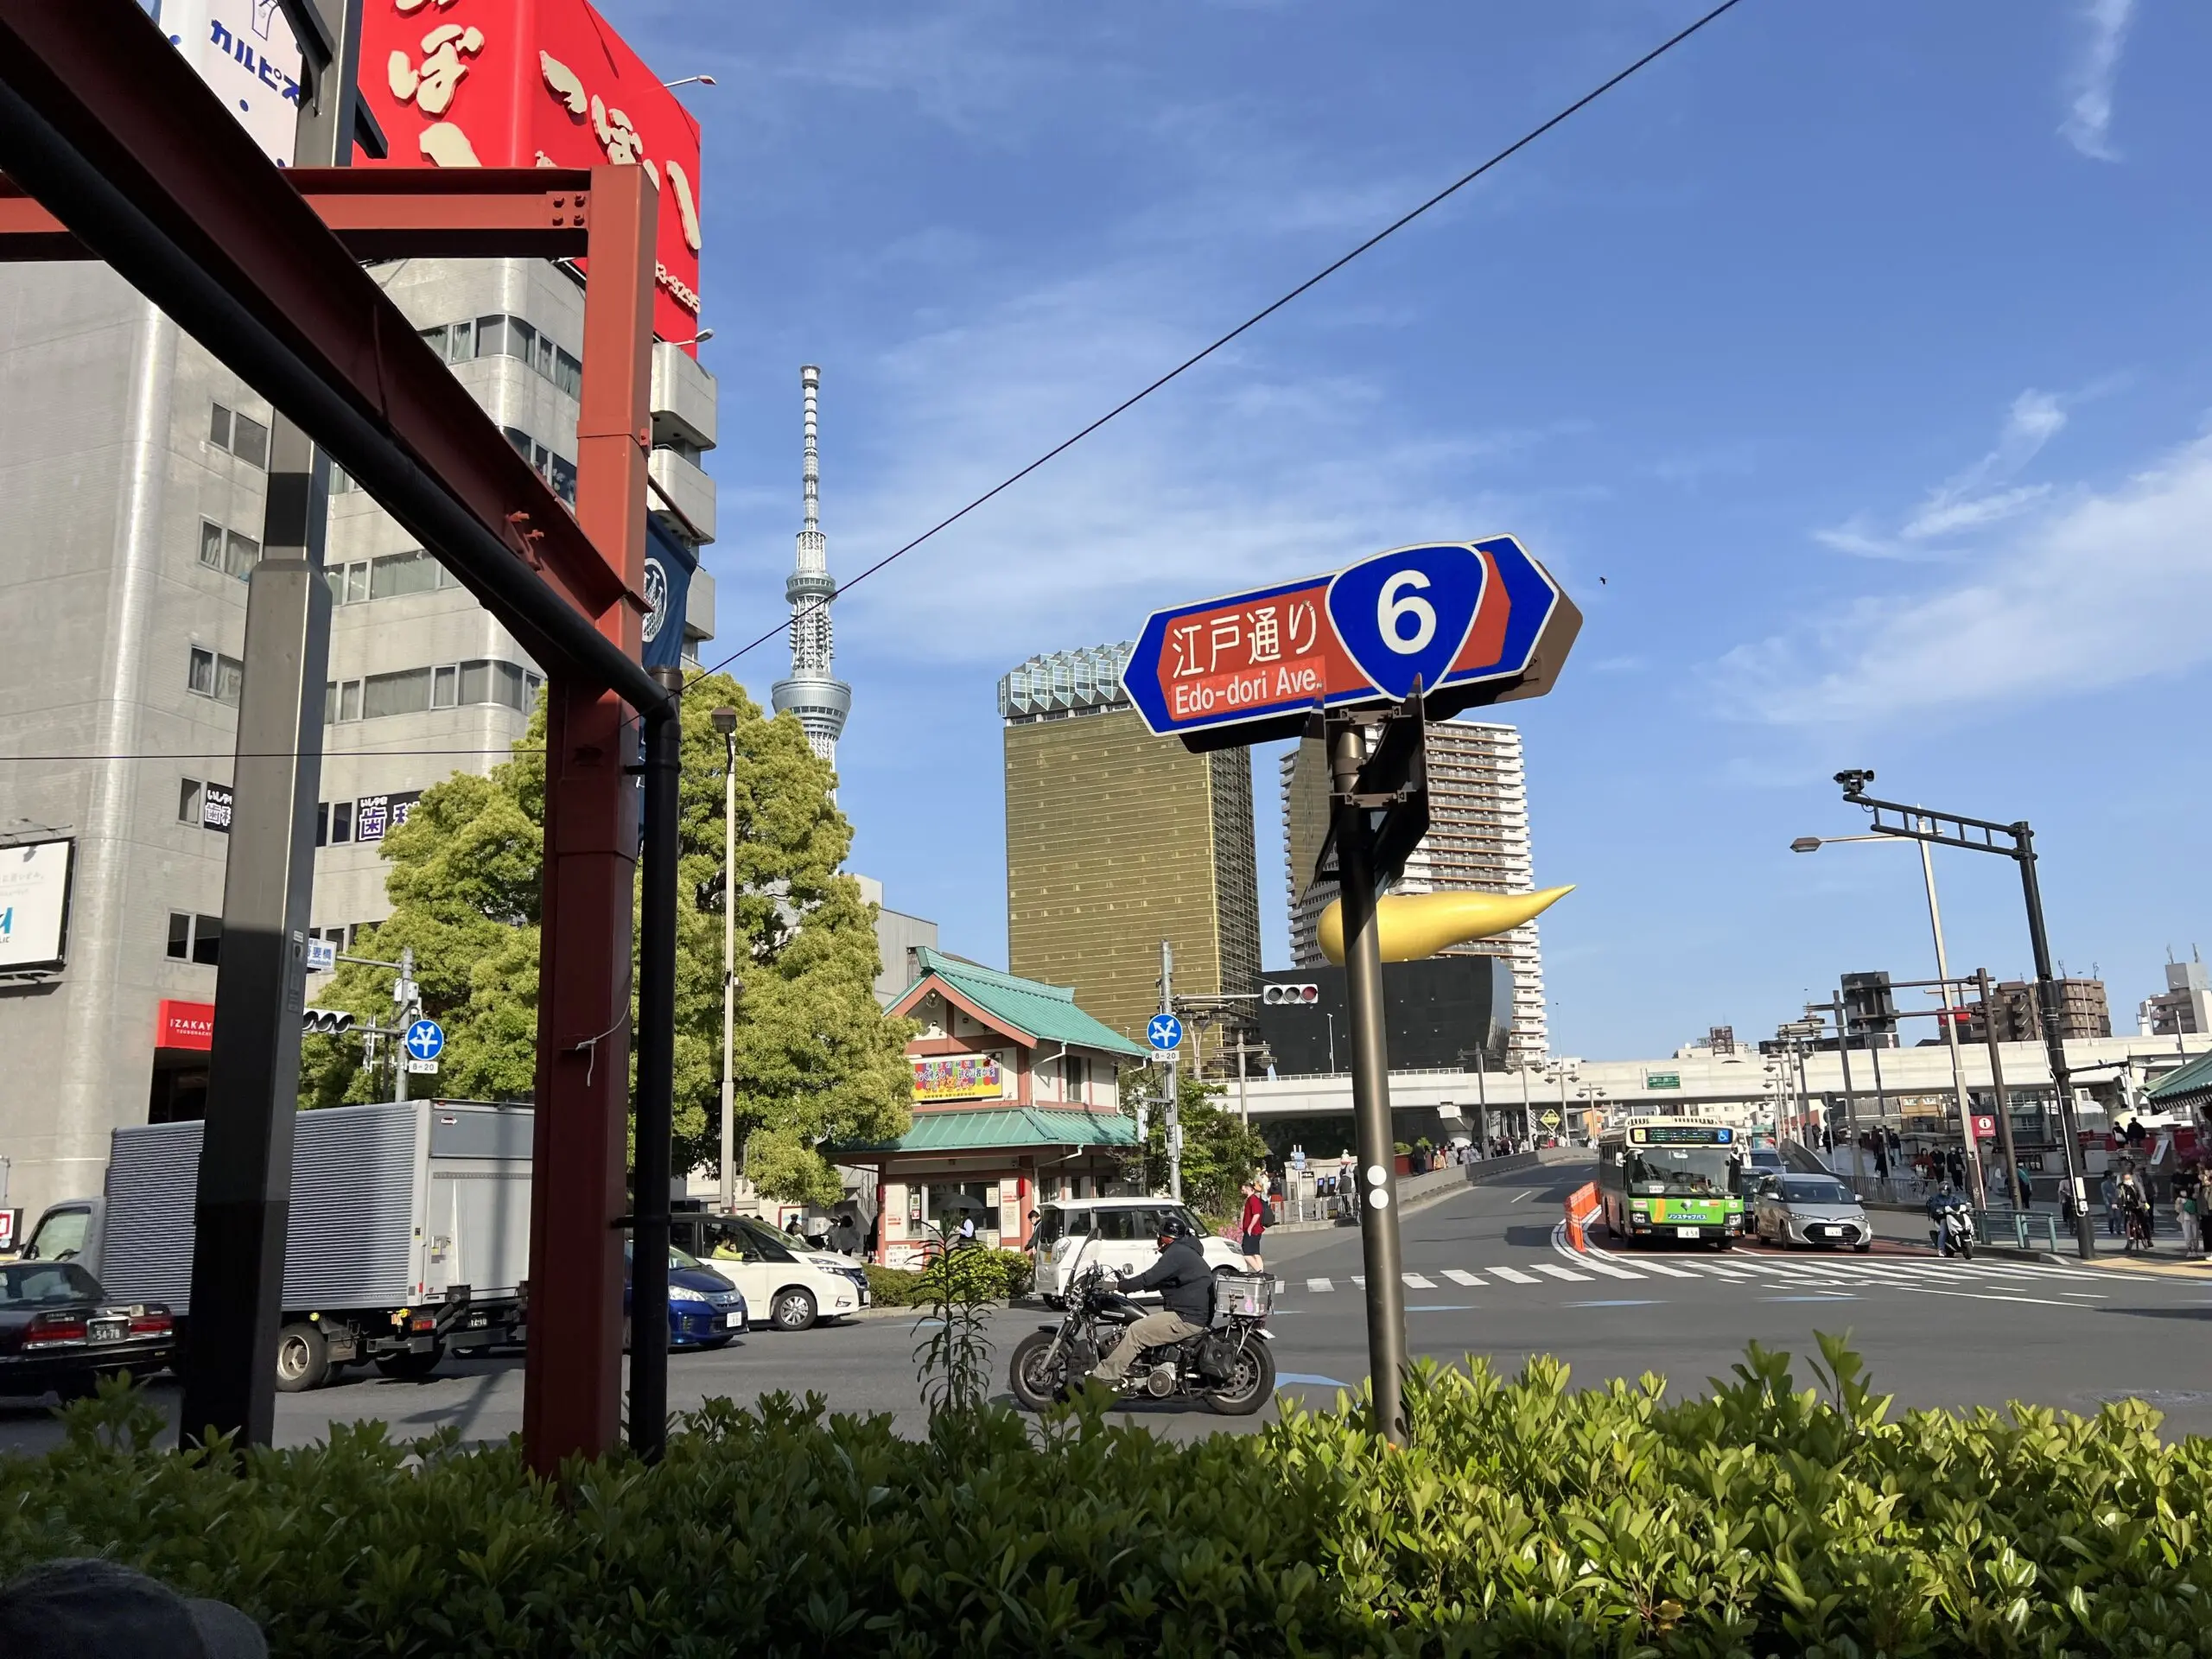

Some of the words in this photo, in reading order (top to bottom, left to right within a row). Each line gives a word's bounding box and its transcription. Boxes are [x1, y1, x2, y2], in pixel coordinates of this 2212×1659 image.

[210, 19, 301, 108] カルピス
[1172, 600, 1317, 679] 江戸通り
[1376, 569, 1437, 655] 6
[1175, 670, 1268, 715] Edo-dori
[1275, 666, 1323, 696] Ave.
[169, 1019, 213, 1031] IZAKAY
